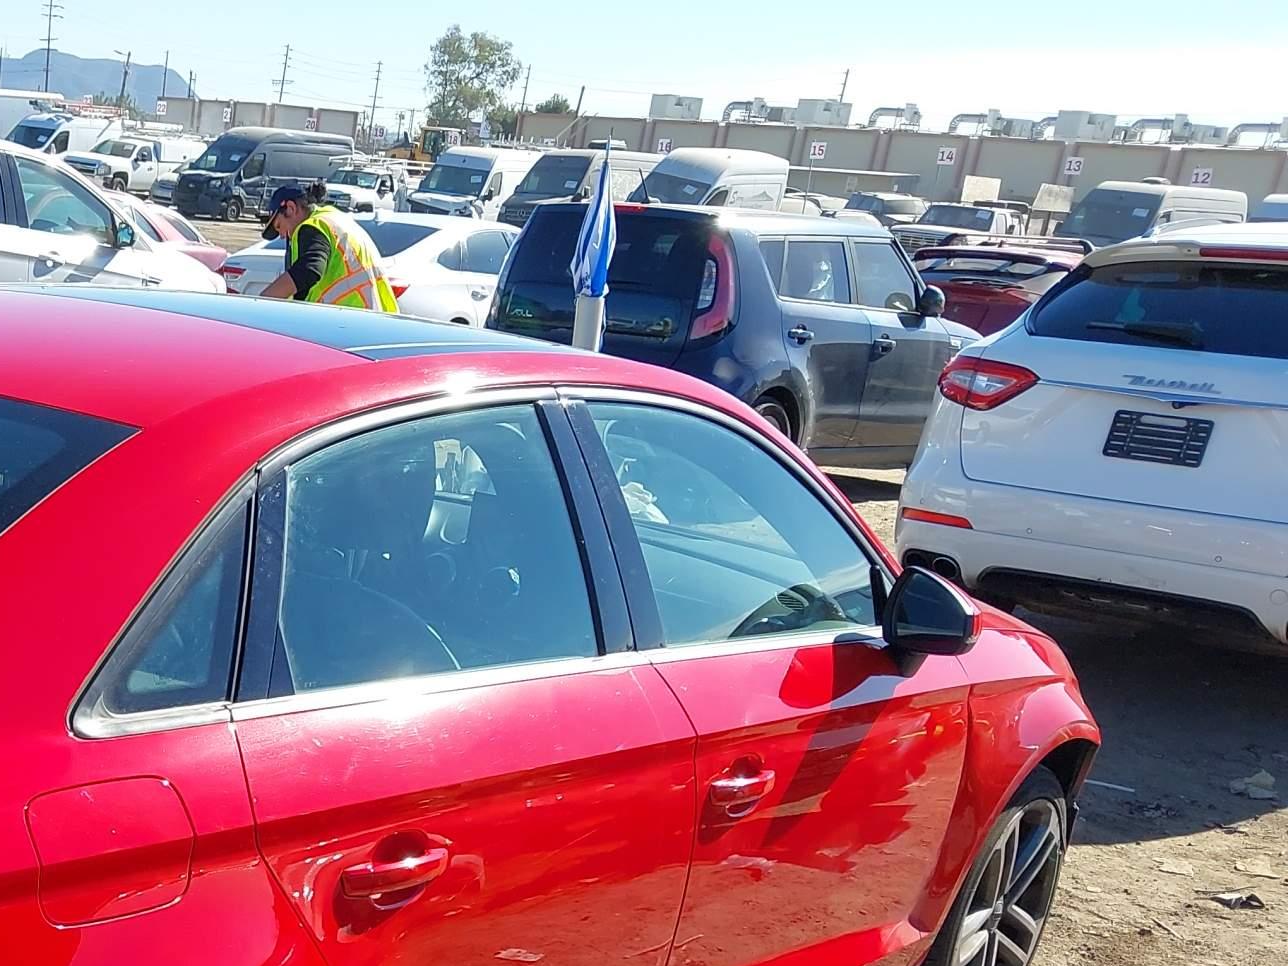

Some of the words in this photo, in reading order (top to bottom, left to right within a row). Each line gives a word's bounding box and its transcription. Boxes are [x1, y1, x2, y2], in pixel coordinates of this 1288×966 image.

[157, 104, 166, 112] 22
[305, 120, 316, 129] 20
[374, 128, 384, 137] 19
[449, 135, 458, 145] 18
[811, 145, 825, 156] 15
[938, 150, 954, 161] 14
[1065, 160, 1082, 171] 13
[1192, 172, 1210, 184] 12
